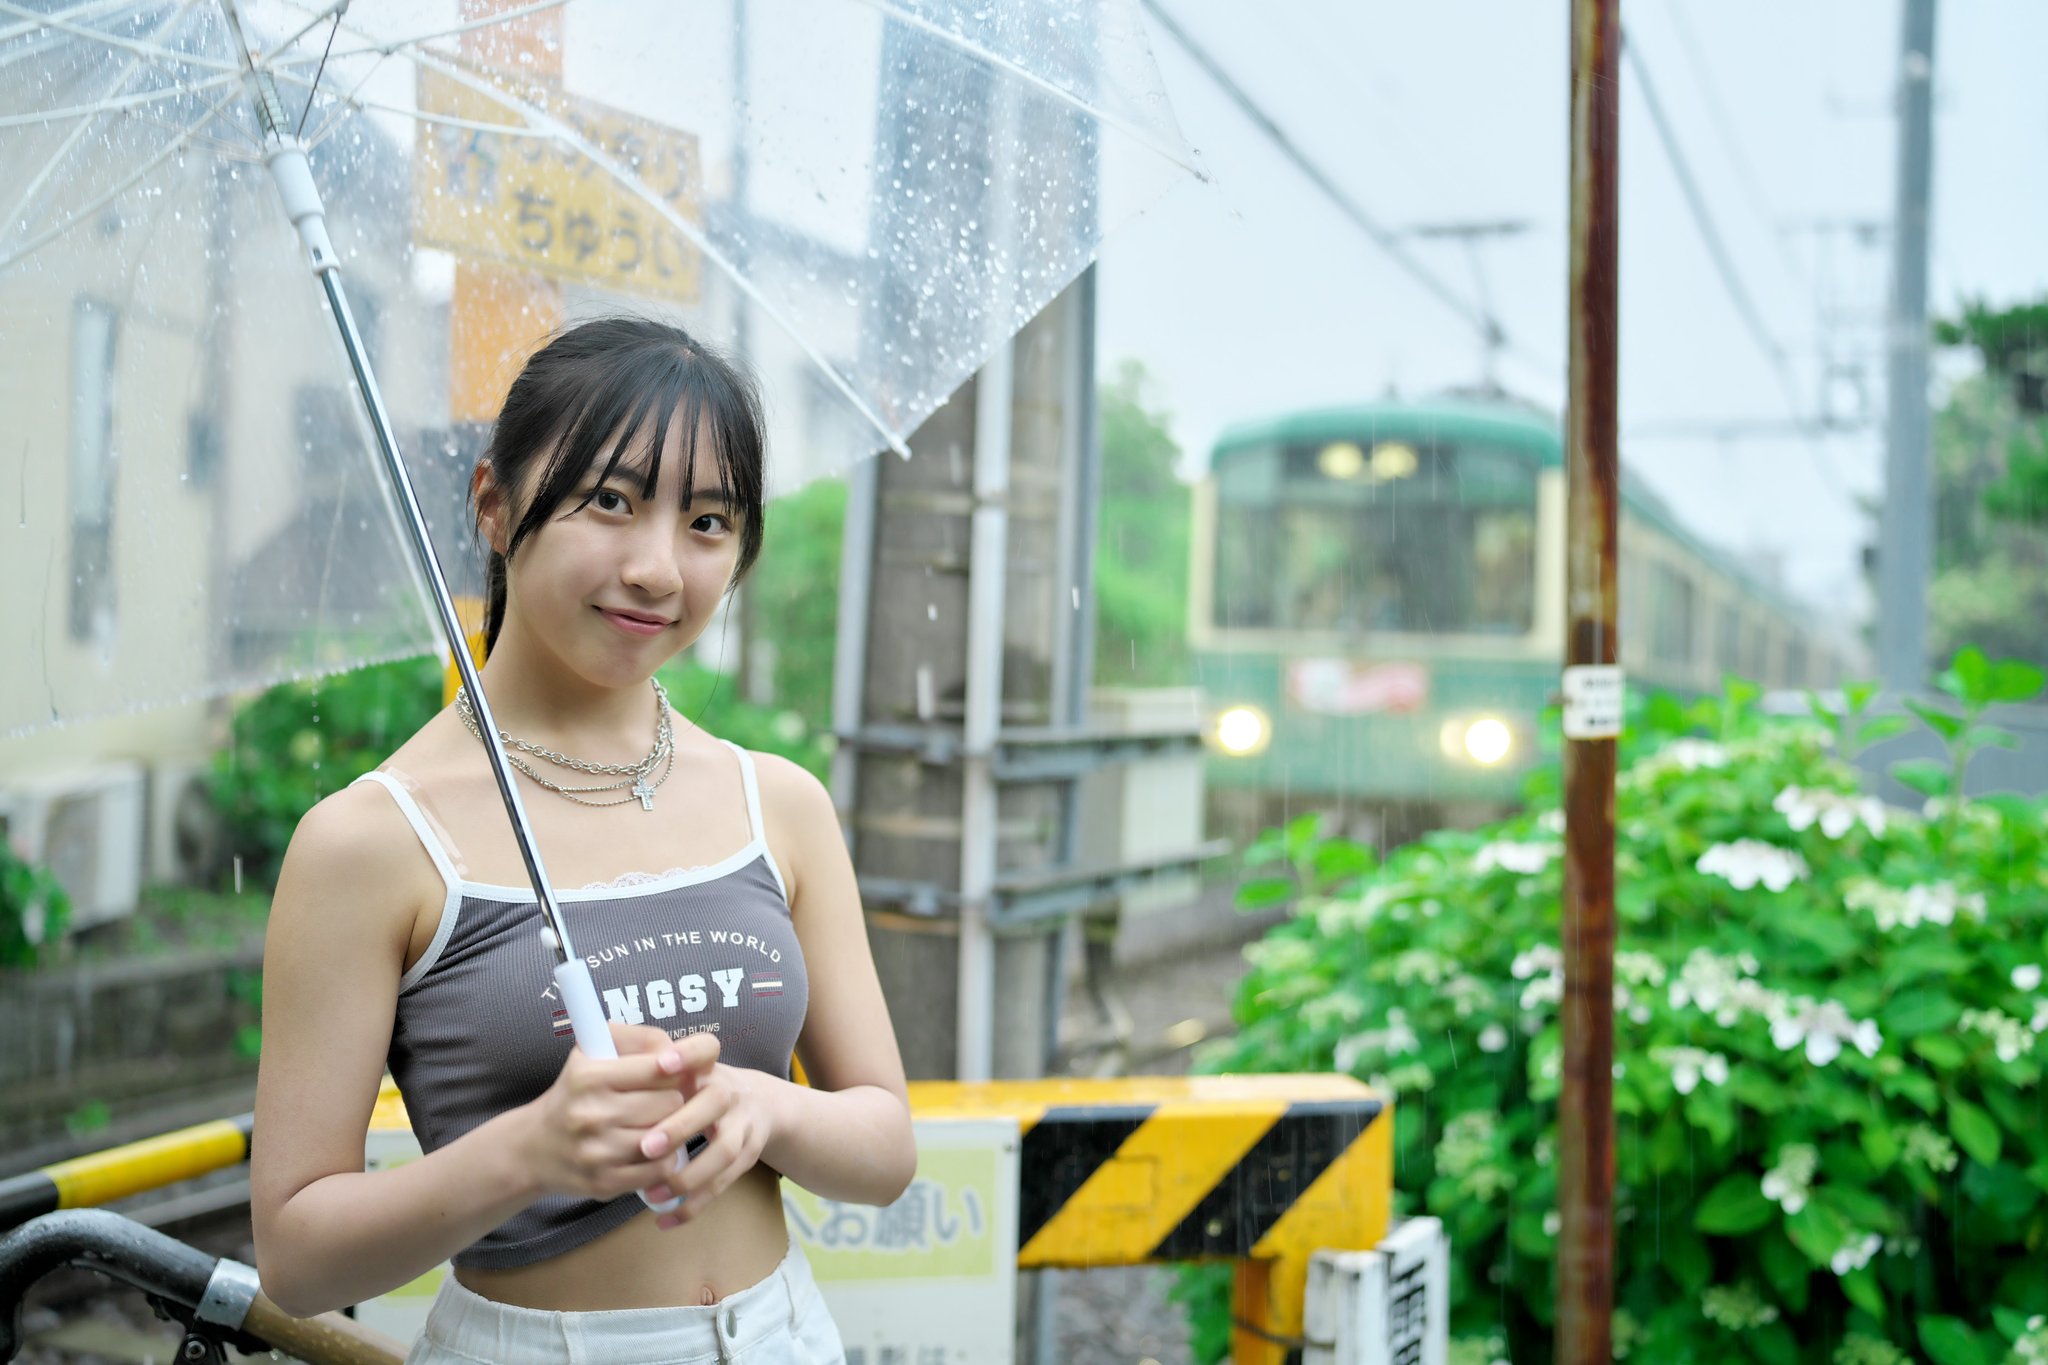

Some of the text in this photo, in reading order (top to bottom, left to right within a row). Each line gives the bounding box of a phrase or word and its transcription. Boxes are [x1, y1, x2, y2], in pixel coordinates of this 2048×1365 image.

[514, 184, 690, 278] ちゅうい
[586, 944, 630, 969] SUN
[634, 936, 657, 953] IN
[662, 931, 702, 946] THE
[709, 931, 781, 963] WORLD
[688, 1022, 720, 1037] BLOWS
